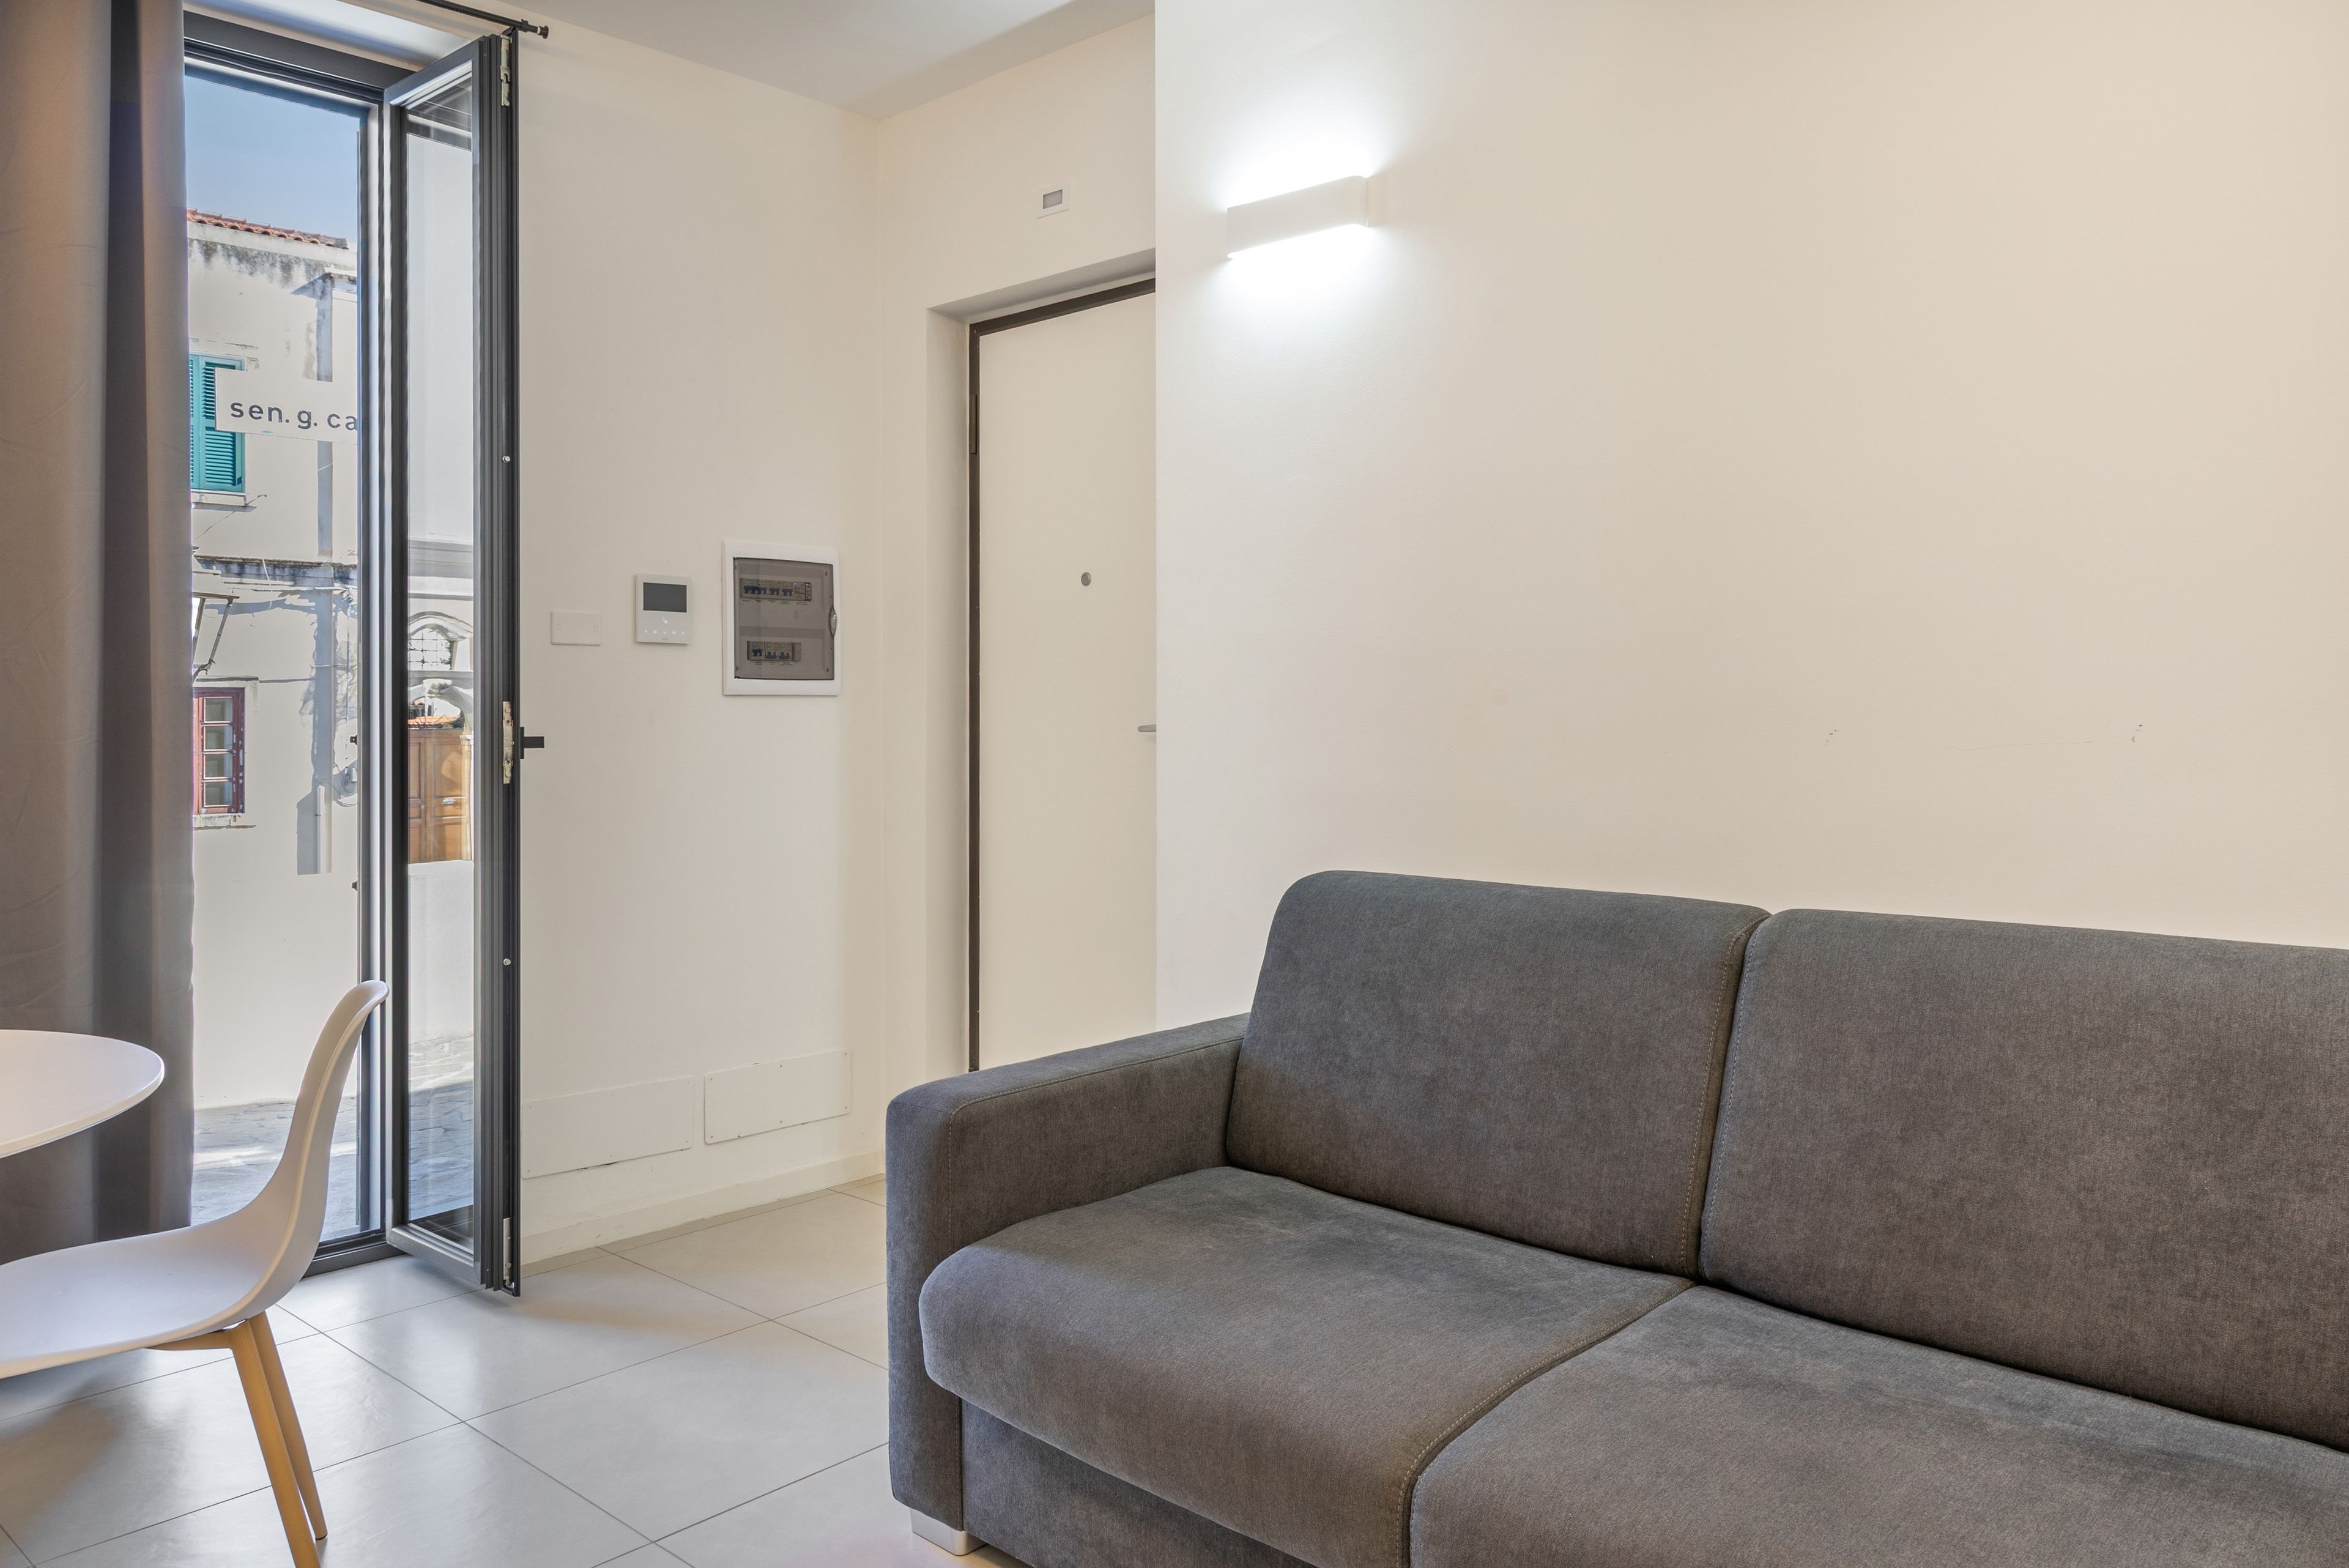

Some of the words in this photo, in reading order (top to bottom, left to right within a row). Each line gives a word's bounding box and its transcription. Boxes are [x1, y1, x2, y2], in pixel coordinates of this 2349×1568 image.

[230, 402, 290, 423] sen.
[297, 410, 318, 429] g.
[327, 413, 358, 431] ca
